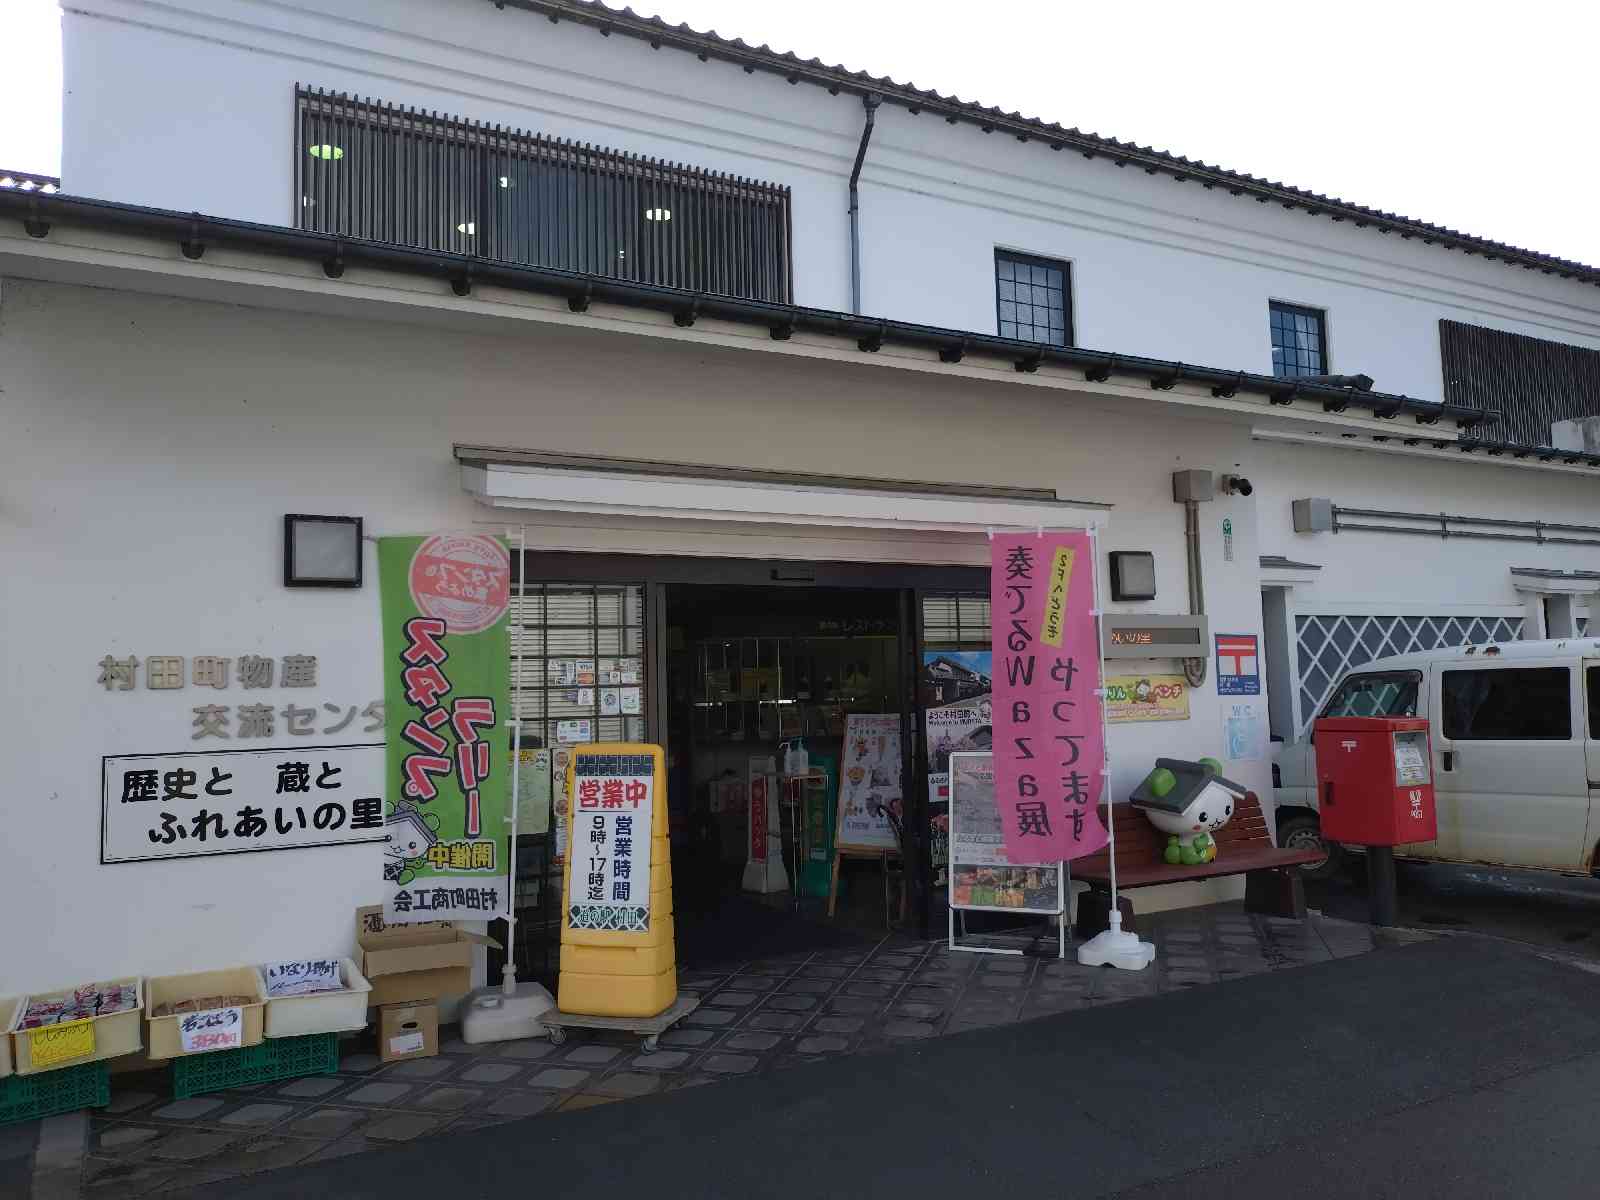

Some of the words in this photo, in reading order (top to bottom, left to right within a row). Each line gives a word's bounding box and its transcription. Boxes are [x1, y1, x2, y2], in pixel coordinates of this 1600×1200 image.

[98, 653, 317, 691] 村田町物産
[1152, 684, 1183, 699] ベンチ
[121, 767, 233, 803] 歴史と
[276, 762, 343, 795] 蔵と
[578, 778, 648, 809] 営業中
[148, 797, 384, 843] ふれあいの里
[612, 815, 633, 902] 営業時間
